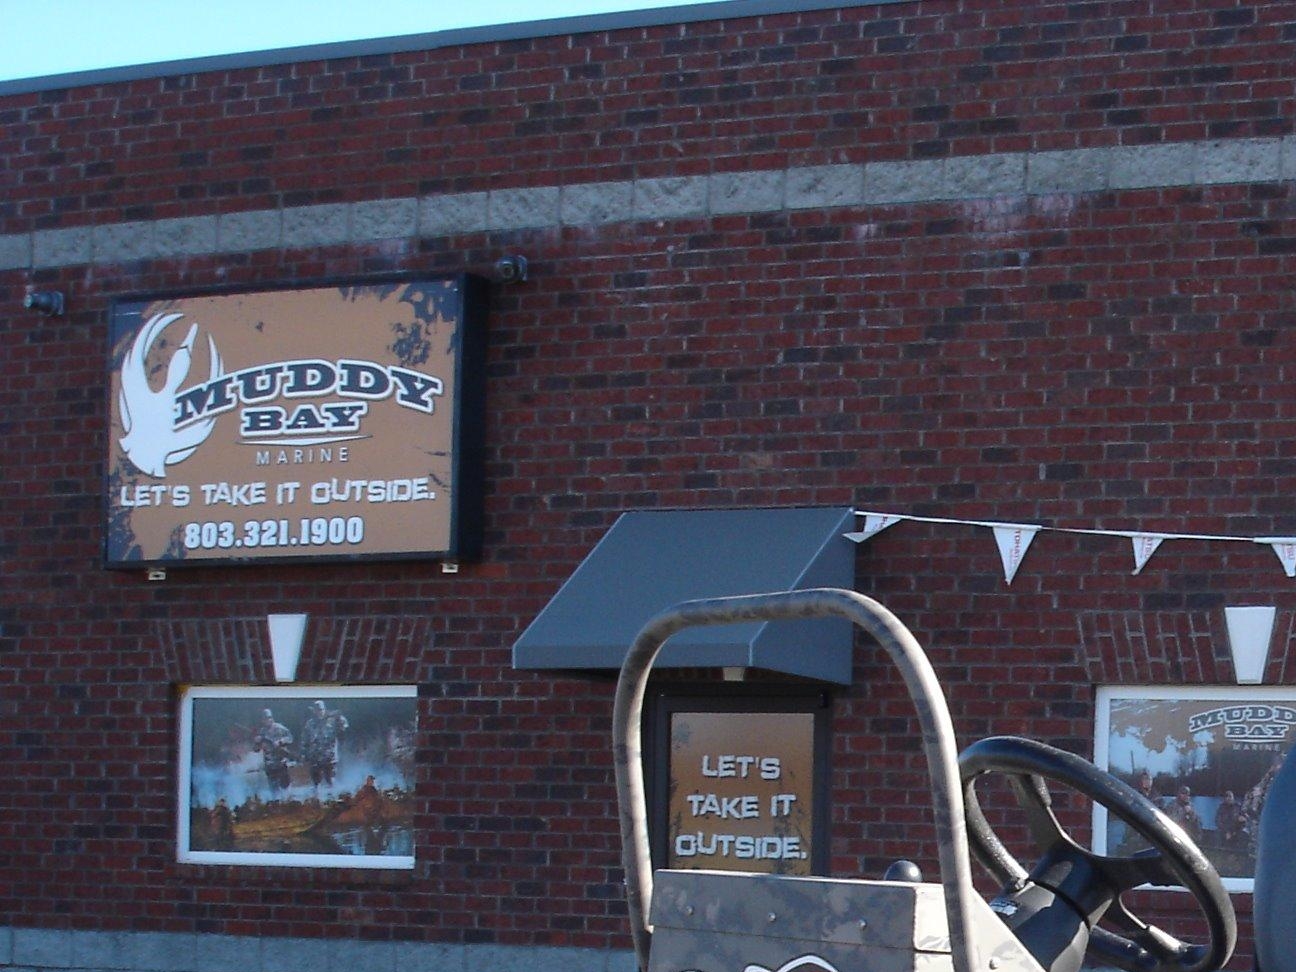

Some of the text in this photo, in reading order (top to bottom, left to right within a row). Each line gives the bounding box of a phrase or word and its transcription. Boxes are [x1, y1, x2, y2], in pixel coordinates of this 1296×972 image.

[172, 358, 443, 430] MUDDY
[240, 401, 369, 437] BAY
[255, 446, 350, 466] MARINE
[120, 477, 436, 507] LET'S TAKE IT OUTSIDE.
[184, 516, 365, 549] 803.321.1900
[1224, 724, 1289, 738] BAY
[1232, 743, 1281, 752] MARINE
[702, 755, 781, 780] LET'S
[687, 793, 797, 818] TAKE IT
[675, 831, 808, 860] OUTSIDE.
